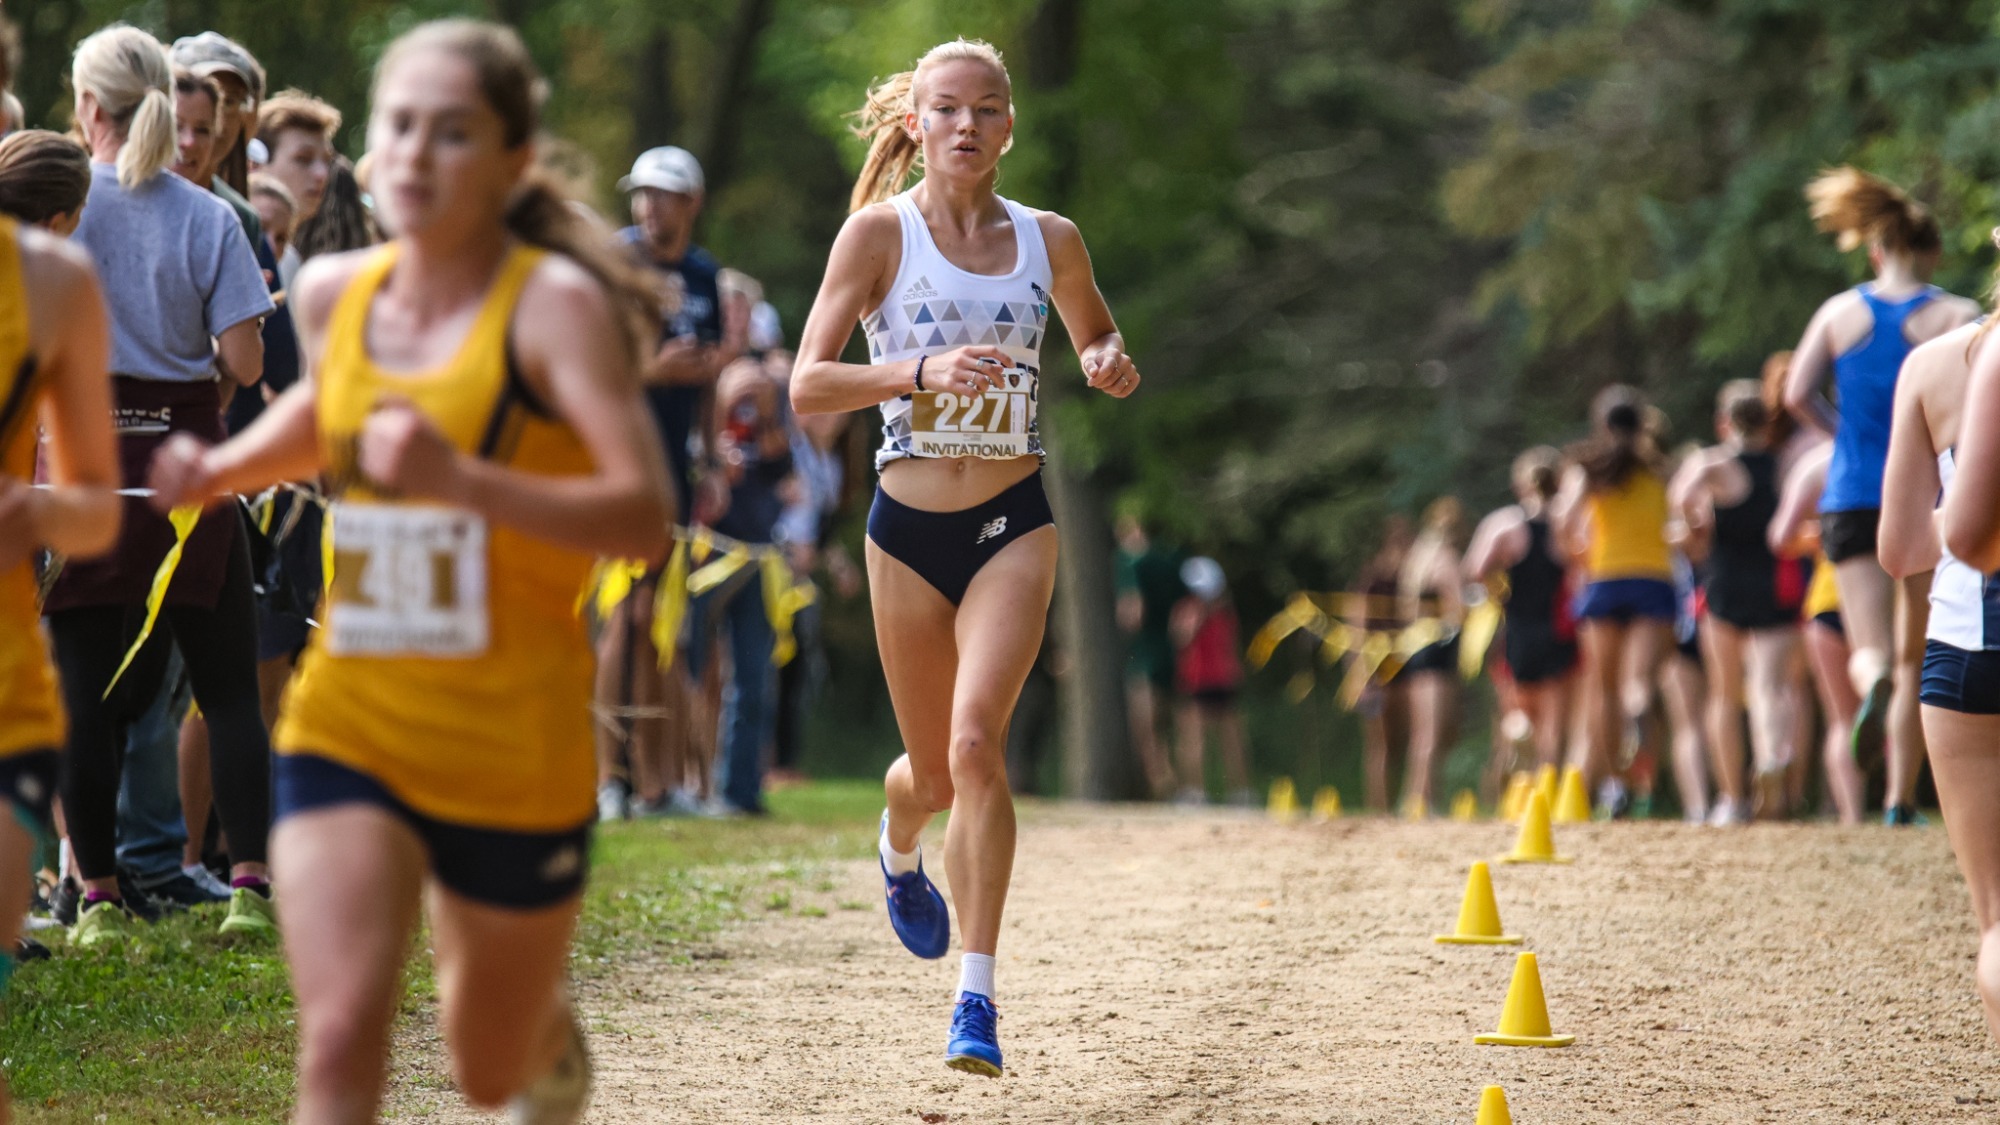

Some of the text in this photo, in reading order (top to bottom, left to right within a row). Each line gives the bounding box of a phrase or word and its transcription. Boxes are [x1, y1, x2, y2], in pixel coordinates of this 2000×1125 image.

[902, 290, 938, 301] adidas
[934, 392, 1009, 432] 227
[921, 441, 1019, 457] INVITATIONAL
